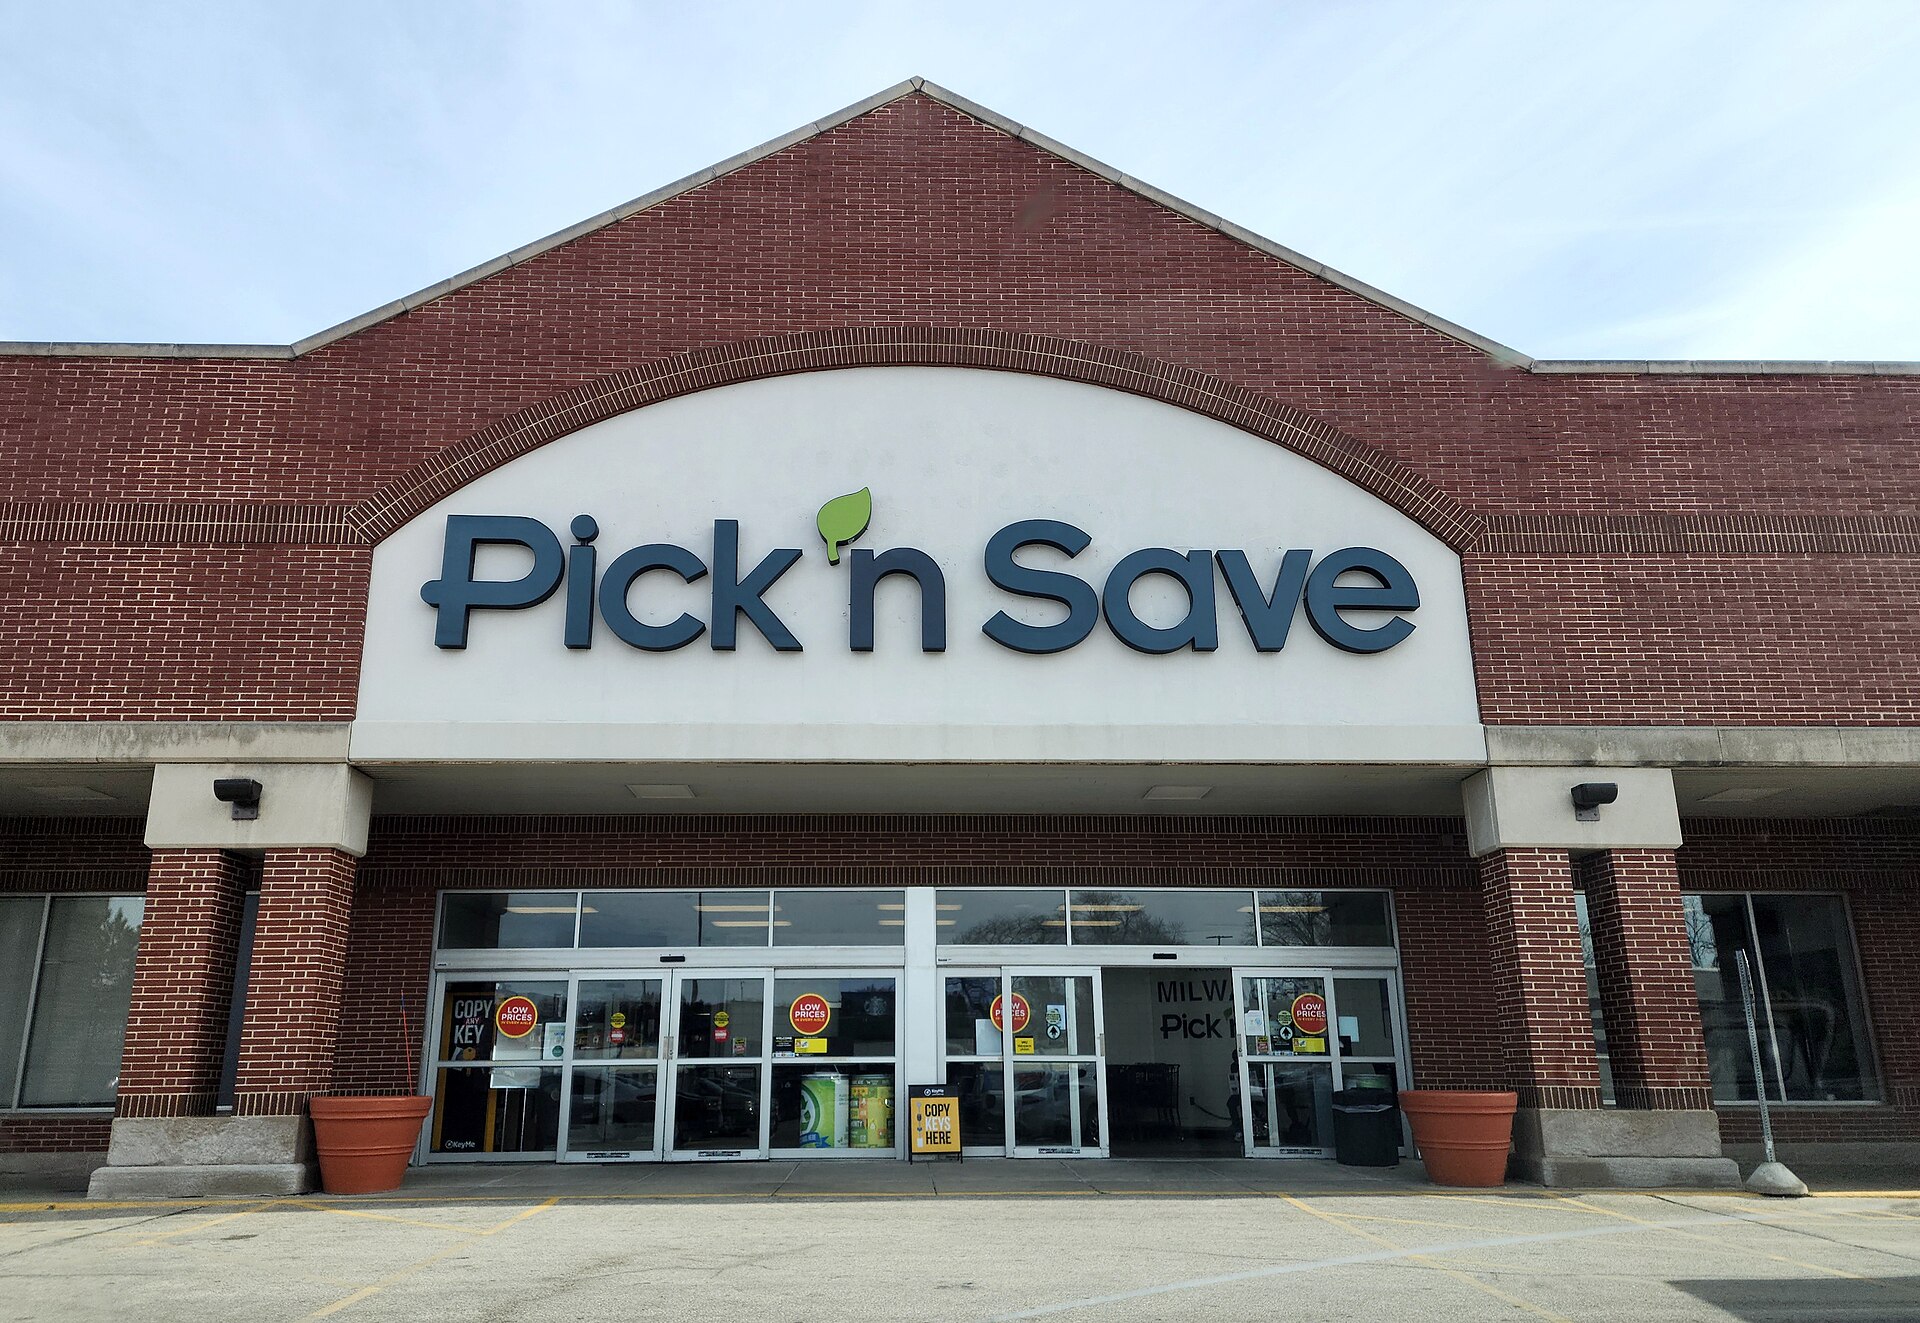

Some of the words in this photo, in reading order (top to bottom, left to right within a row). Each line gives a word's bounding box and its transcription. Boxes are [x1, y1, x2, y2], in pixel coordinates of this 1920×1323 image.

[420, 513, 803, 652] Pick
[982, 518, 1420, 654] Save
[454, 1000, 493, 1019] COPY
[507, 1006, 528, 1014] LOW
[794, 1010, 825, 1018] PRICES
[800, 1003, 820, 1011] LOW
[1296, 1010, 1326, 1018] PRICES
[465, 1017, 480, 1025] ANY
[501, 1013, 532, 1021] PRICES
[1160, 1013, 1223, 1039] Pick
[454, 1025, 484, 1044] KEY
[924, 1103, 950, 1117] COPY
[925, 1117, 951, 1132] KEYS
[925, 1131, 952, 1145] HERE
